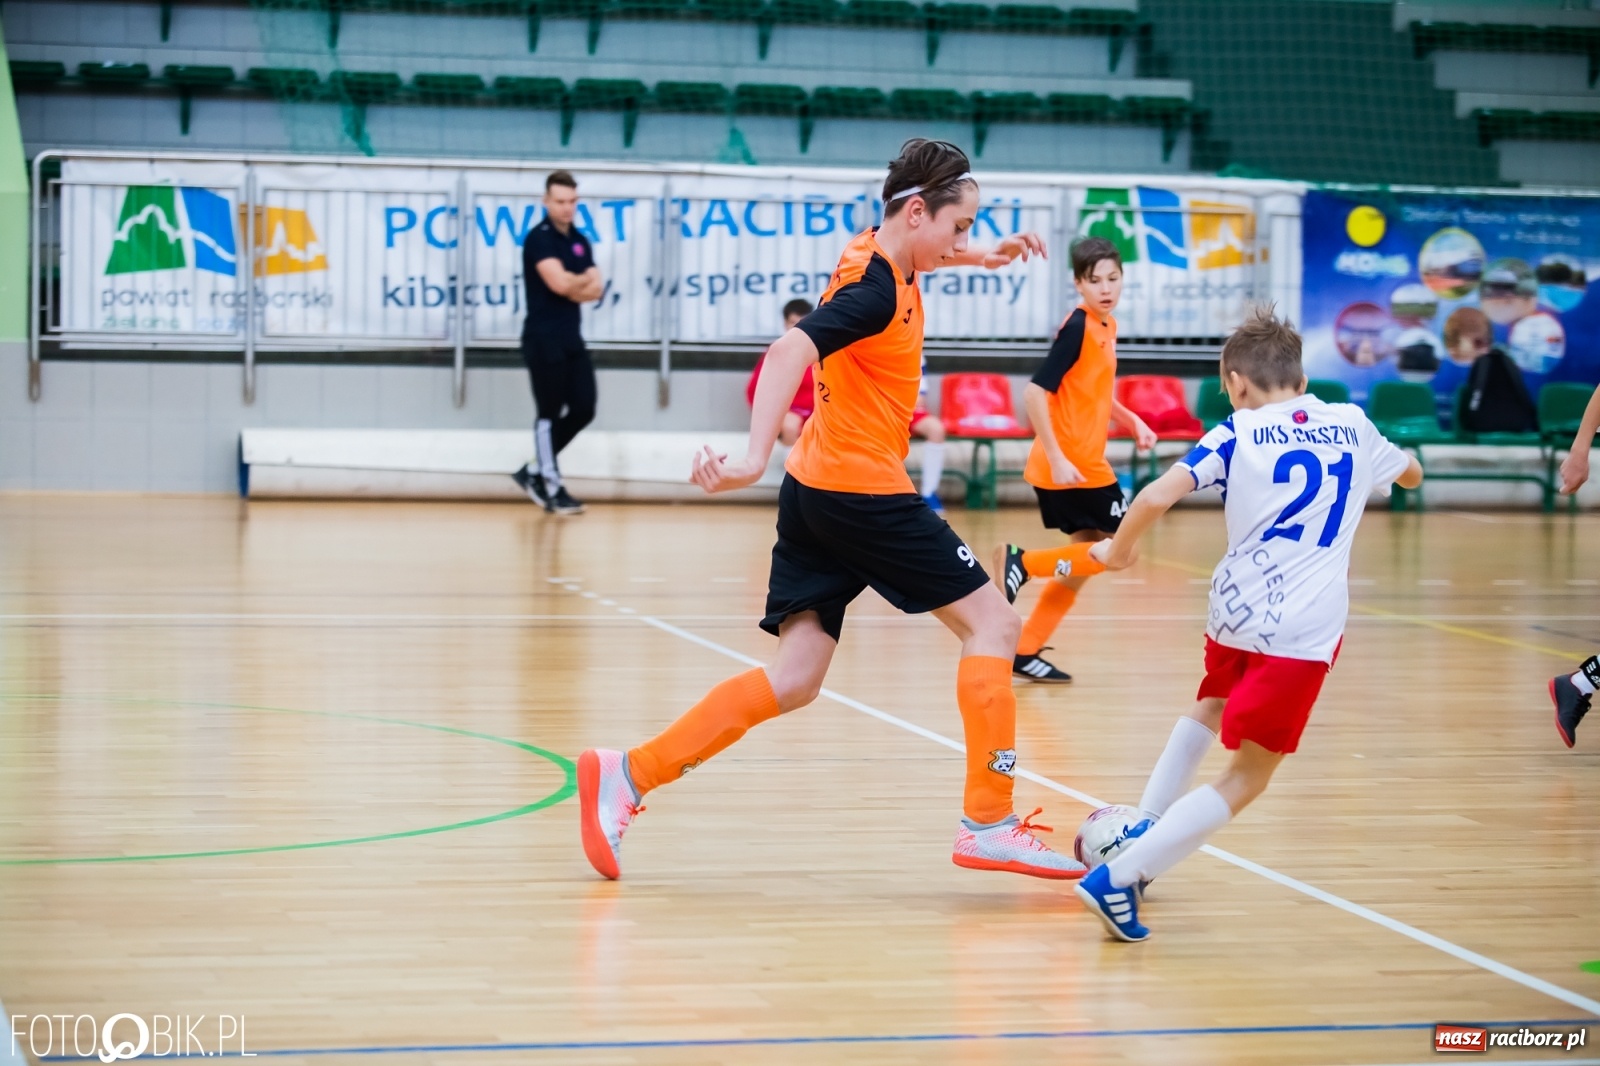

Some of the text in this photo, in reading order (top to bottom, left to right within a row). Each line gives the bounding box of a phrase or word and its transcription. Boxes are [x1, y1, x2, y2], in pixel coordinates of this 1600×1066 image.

[384, 198, 636, 250] POWAT
[1253, 424, 1289, 445] UKS
[1260, 449, 1354, 548] 21
